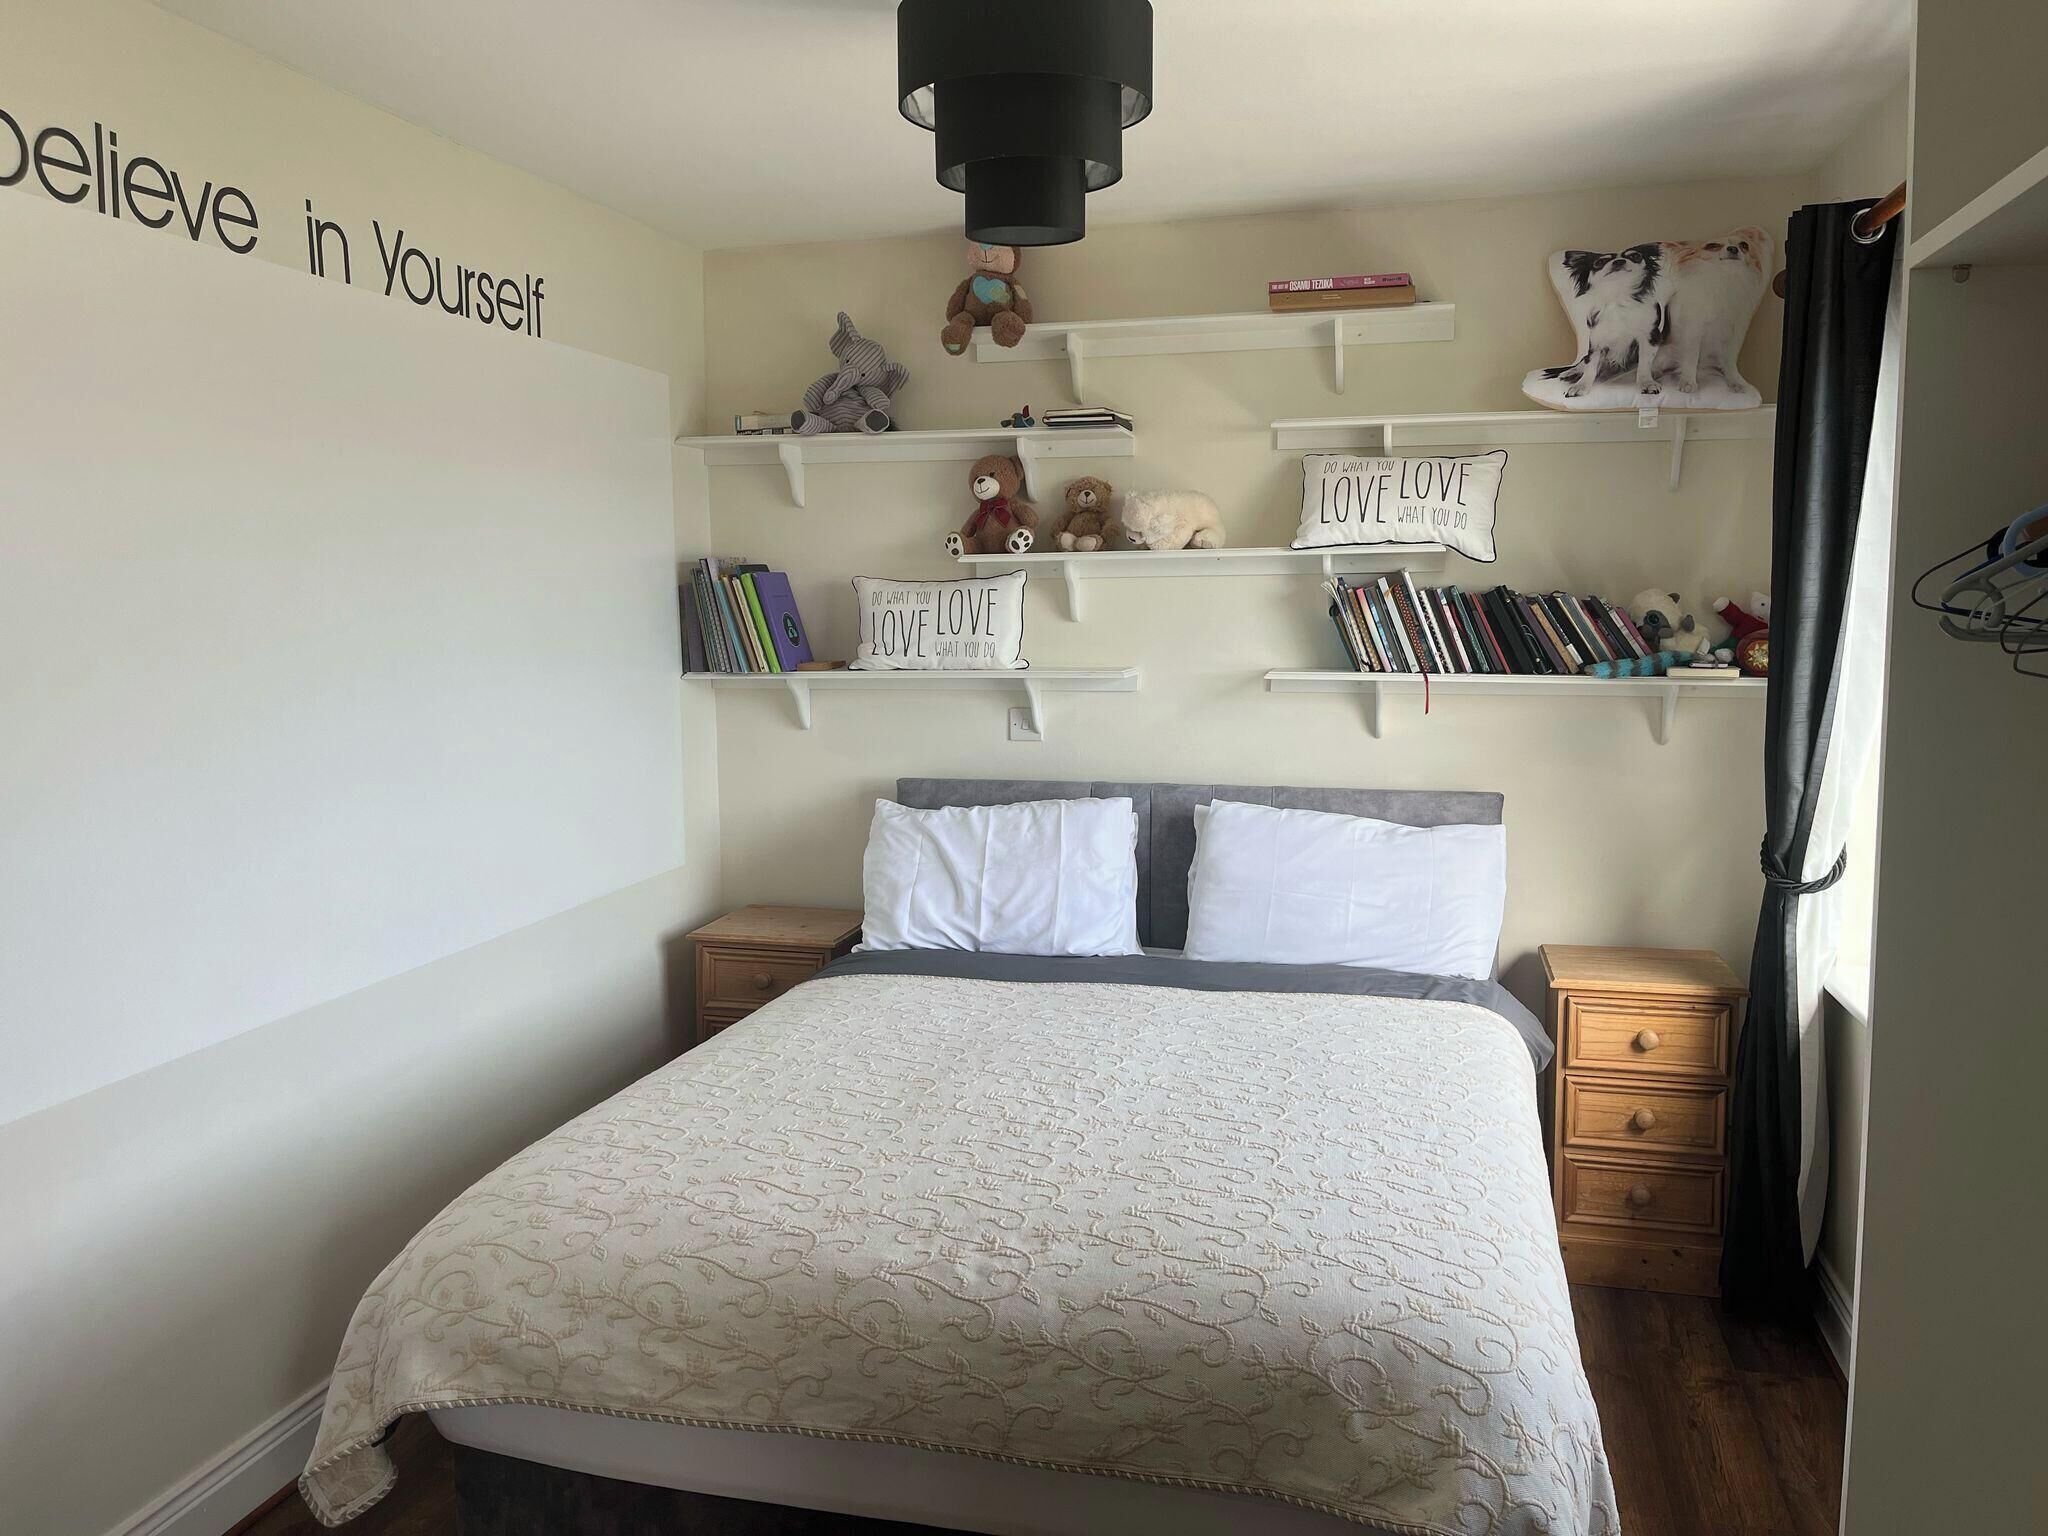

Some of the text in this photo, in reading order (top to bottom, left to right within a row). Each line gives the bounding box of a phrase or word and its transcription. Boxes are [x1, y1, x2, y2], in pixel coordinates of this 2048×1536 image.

[305, 199, 351, 284] in
[372, 220, 545, 338] Yourself
[1289, 280, 1311, 291] OSAMU
[1311, 278, 1334, 290] TEZUKA
[1323, 460, 1395, 474] DO WHAT YOU
[1399, 460, 1473, 506] LOVE
[1320, 474, 1392, 524] LOVE
[1397, 505, 1468, 530] WHAT YOU DO
[871, 591, 932, 606] DO WHAT YOU
[936, 588, 998, 636] LOVE
[871, 609, 930, 658] LOVE
[934, 640, 996, 659] WHAT YOU DO
